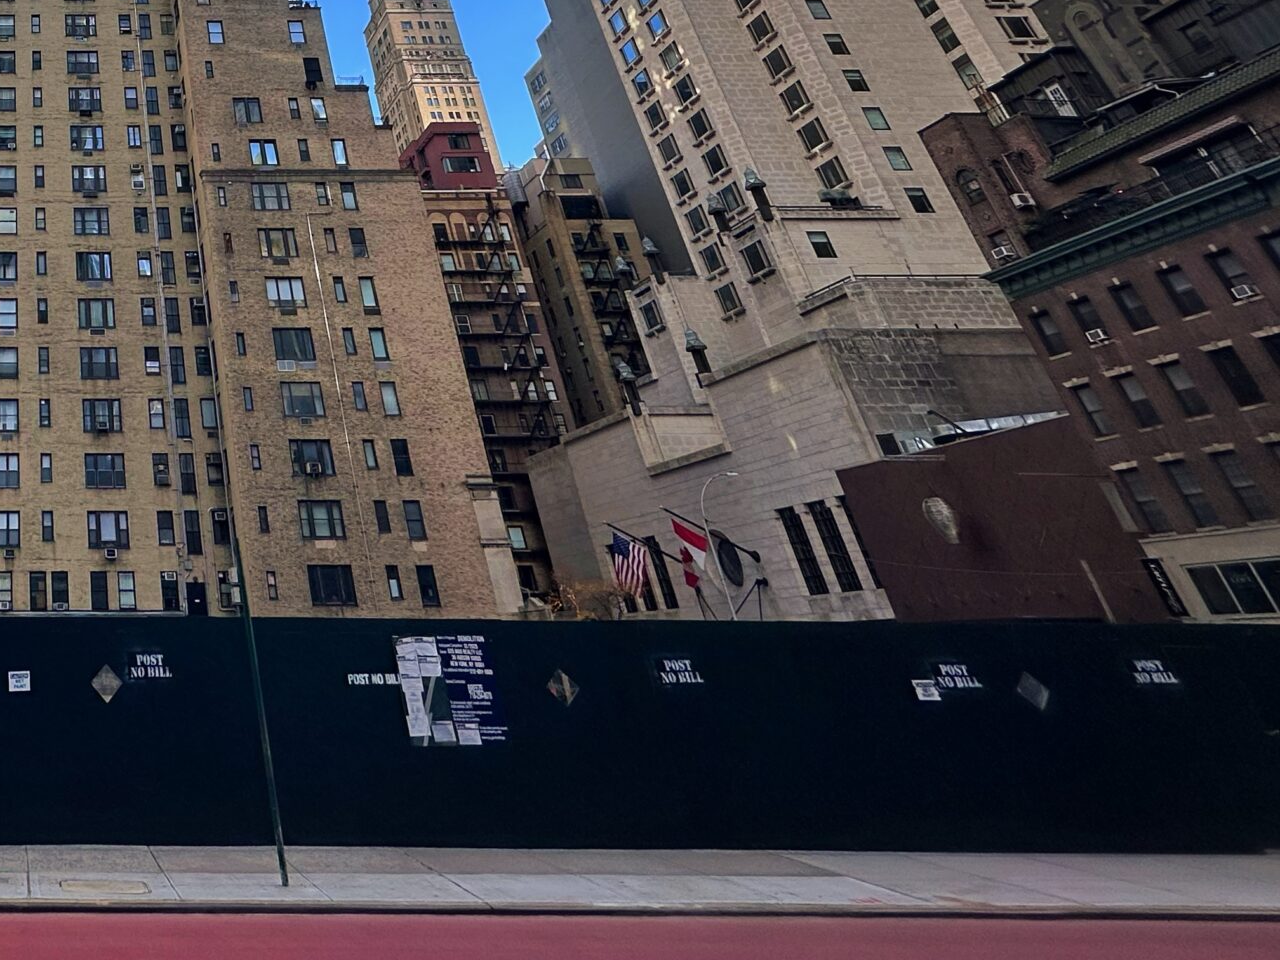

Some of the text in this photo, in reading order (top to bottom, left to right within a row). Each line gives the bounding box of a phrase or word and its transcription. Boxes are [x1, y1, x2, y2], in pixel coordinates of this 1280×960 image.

[136, 654, 164, 666] POST
[663, 659, 692, 671] POST
[1133, 659, 1164, 671] POST
[130, 666, 173, 678] NO BILL
[938, 664, 968, 676] POST
[347, 673, 370, 685] POST
[370, 673, 385, 685] NO
[660, 671, 704, 684] NO BILL
[937, 676, 955, 688] NO
[953, 676, 983, 688] BILL
[1133, 671, 1179, 684] NO BILL
